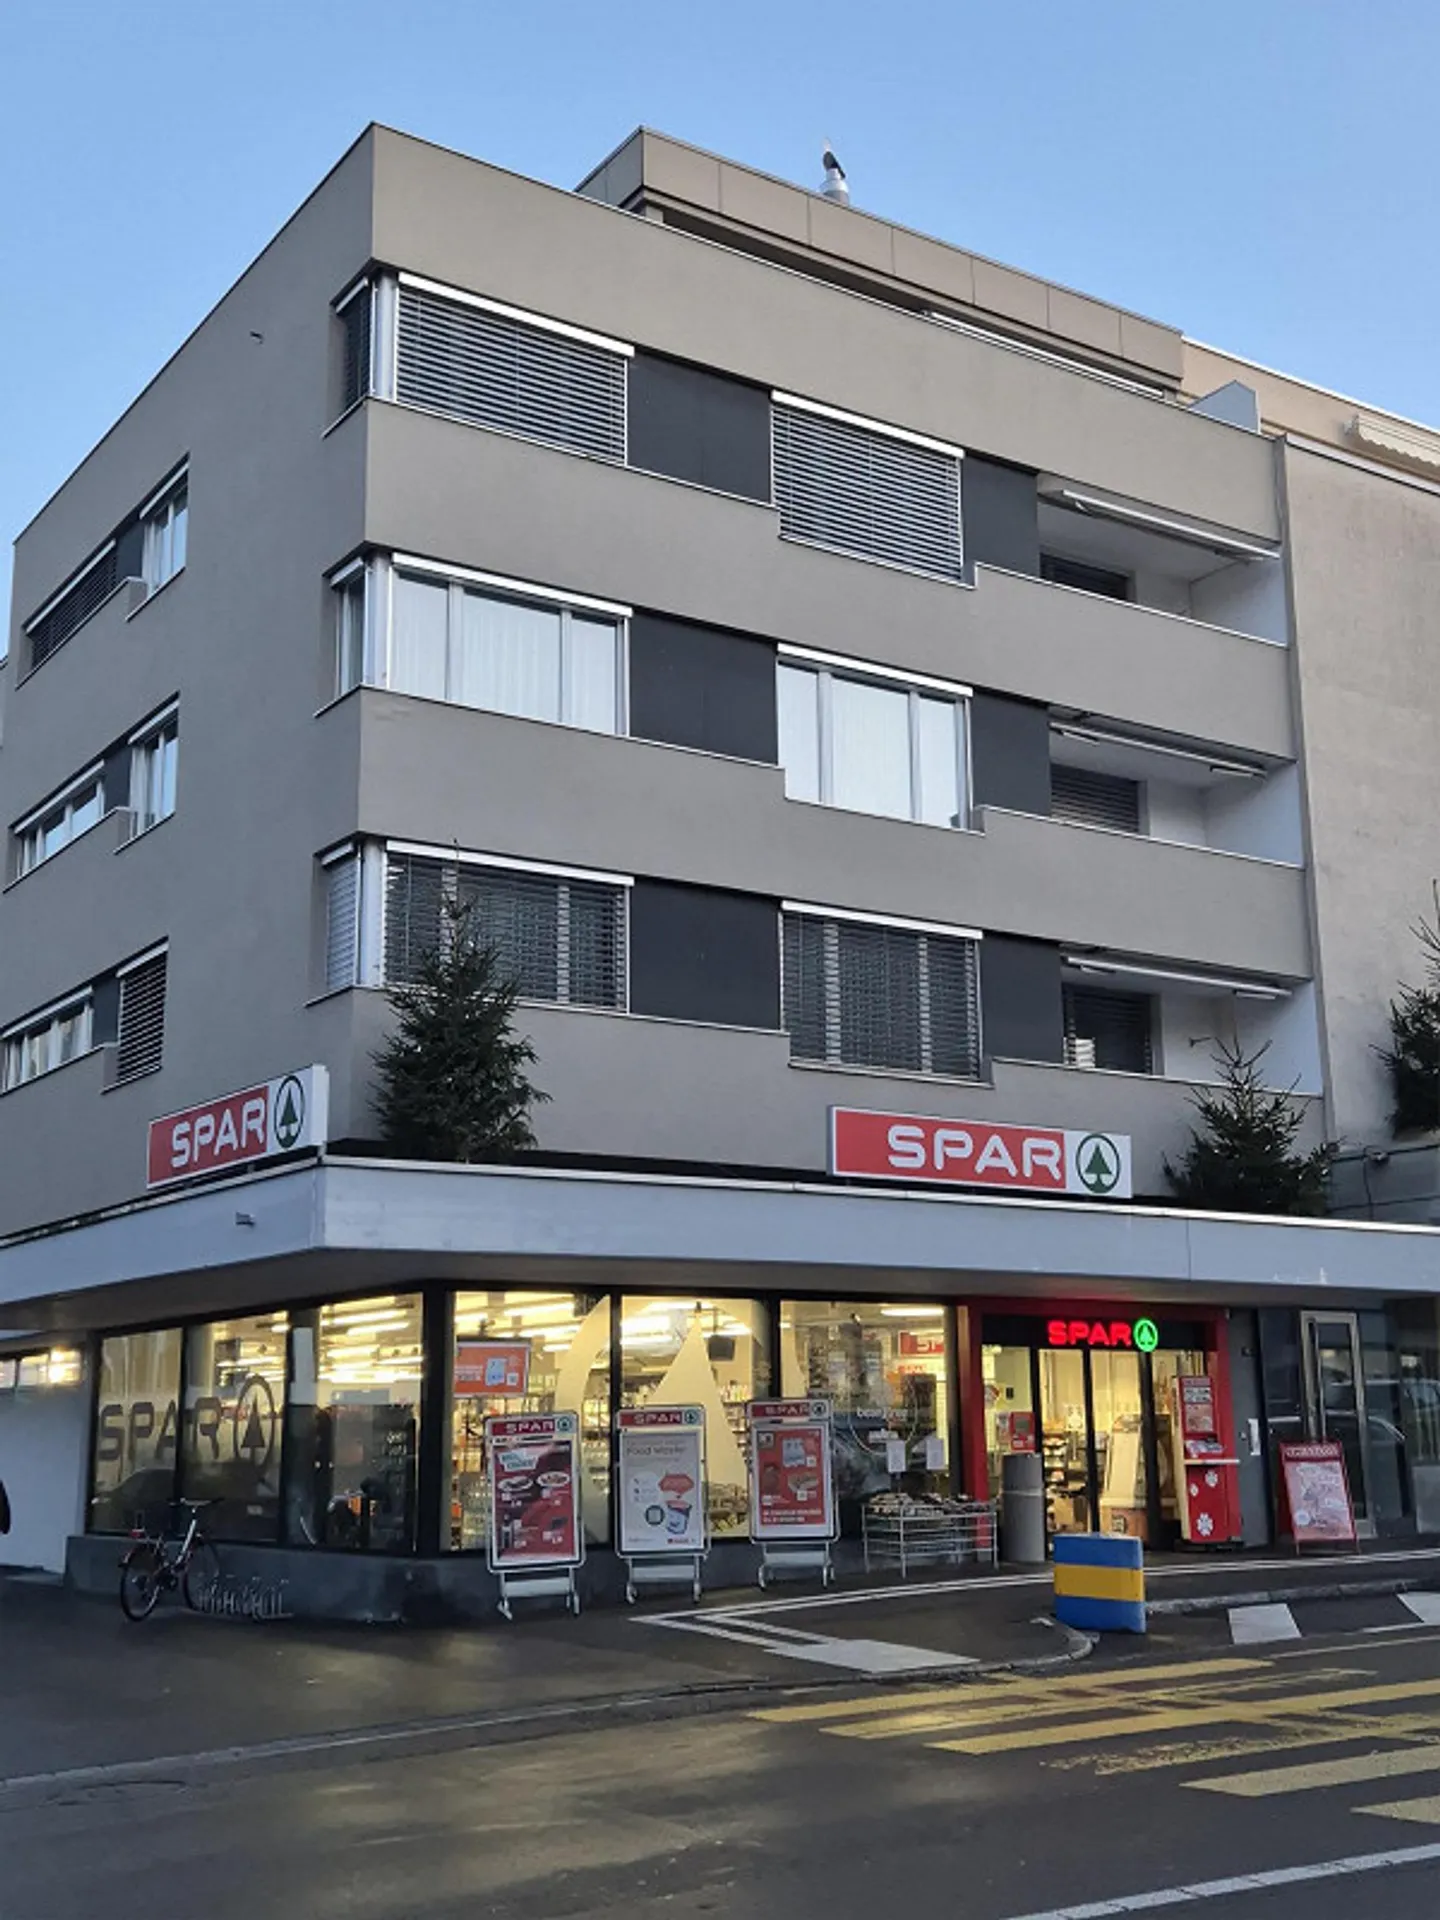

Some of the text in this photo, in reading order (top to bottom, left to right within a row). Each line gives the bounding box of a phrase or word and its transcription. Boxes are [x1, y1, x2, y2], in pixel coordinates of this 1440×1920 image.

[170, 1097, 266, 1168] SPAR
[887, 1125, 1062, 1181] SPAR
[1047, 1320, 1132, 1346] SPAR
[634, 1413, 681, 1425] SPAR
[765, 1403, 810, 1415] SPAR
[99, 1397, 221, 1462] SPAR
[505, 1421, 554, 1434] SPAR
